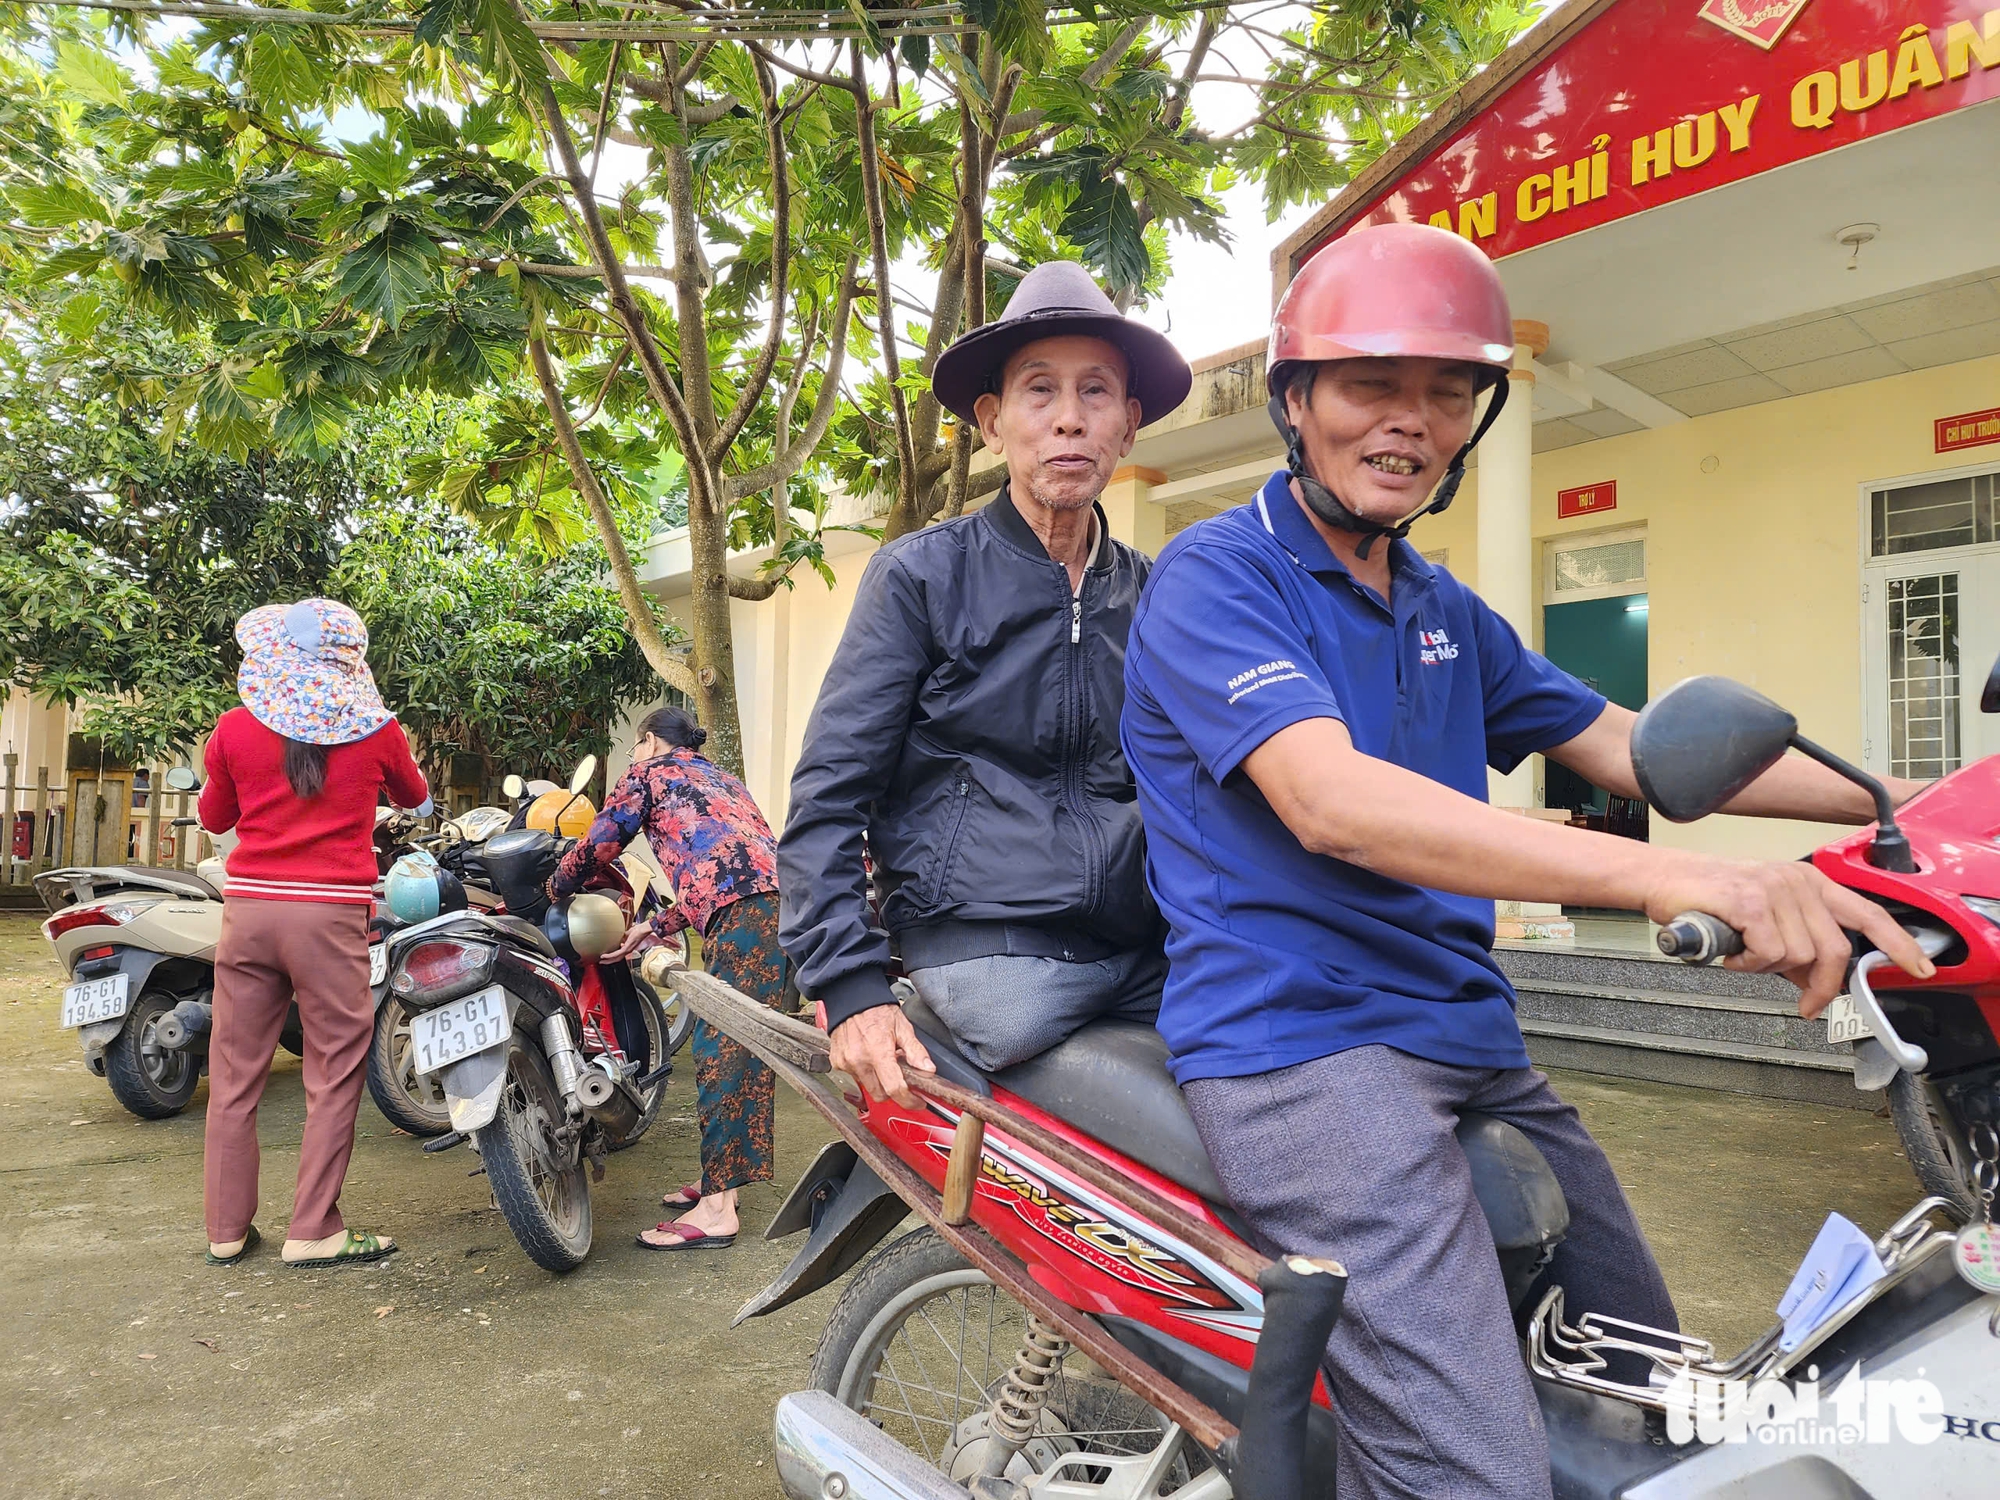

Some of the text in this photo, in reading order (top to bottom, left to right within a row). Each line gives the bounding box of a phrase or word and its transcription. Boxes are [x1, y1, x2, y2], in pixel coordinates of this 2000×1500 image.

[1516, 134, 1611, 223] CHỈ
[1631, 95, 1760, 186] HUY
[1790, 8, 2000, 129] QUÂN
[1227, 660, 1296, 690] NAM GIANG
[67, 997, 122, 1025] 194.58
[74, 979, 117, 1005] 76-G1
[426, 995, 490, 1038] 76-G1
[422, 1014, 501, 1067] 143.87
[982, 1154, 1085, 1223] WAVE
